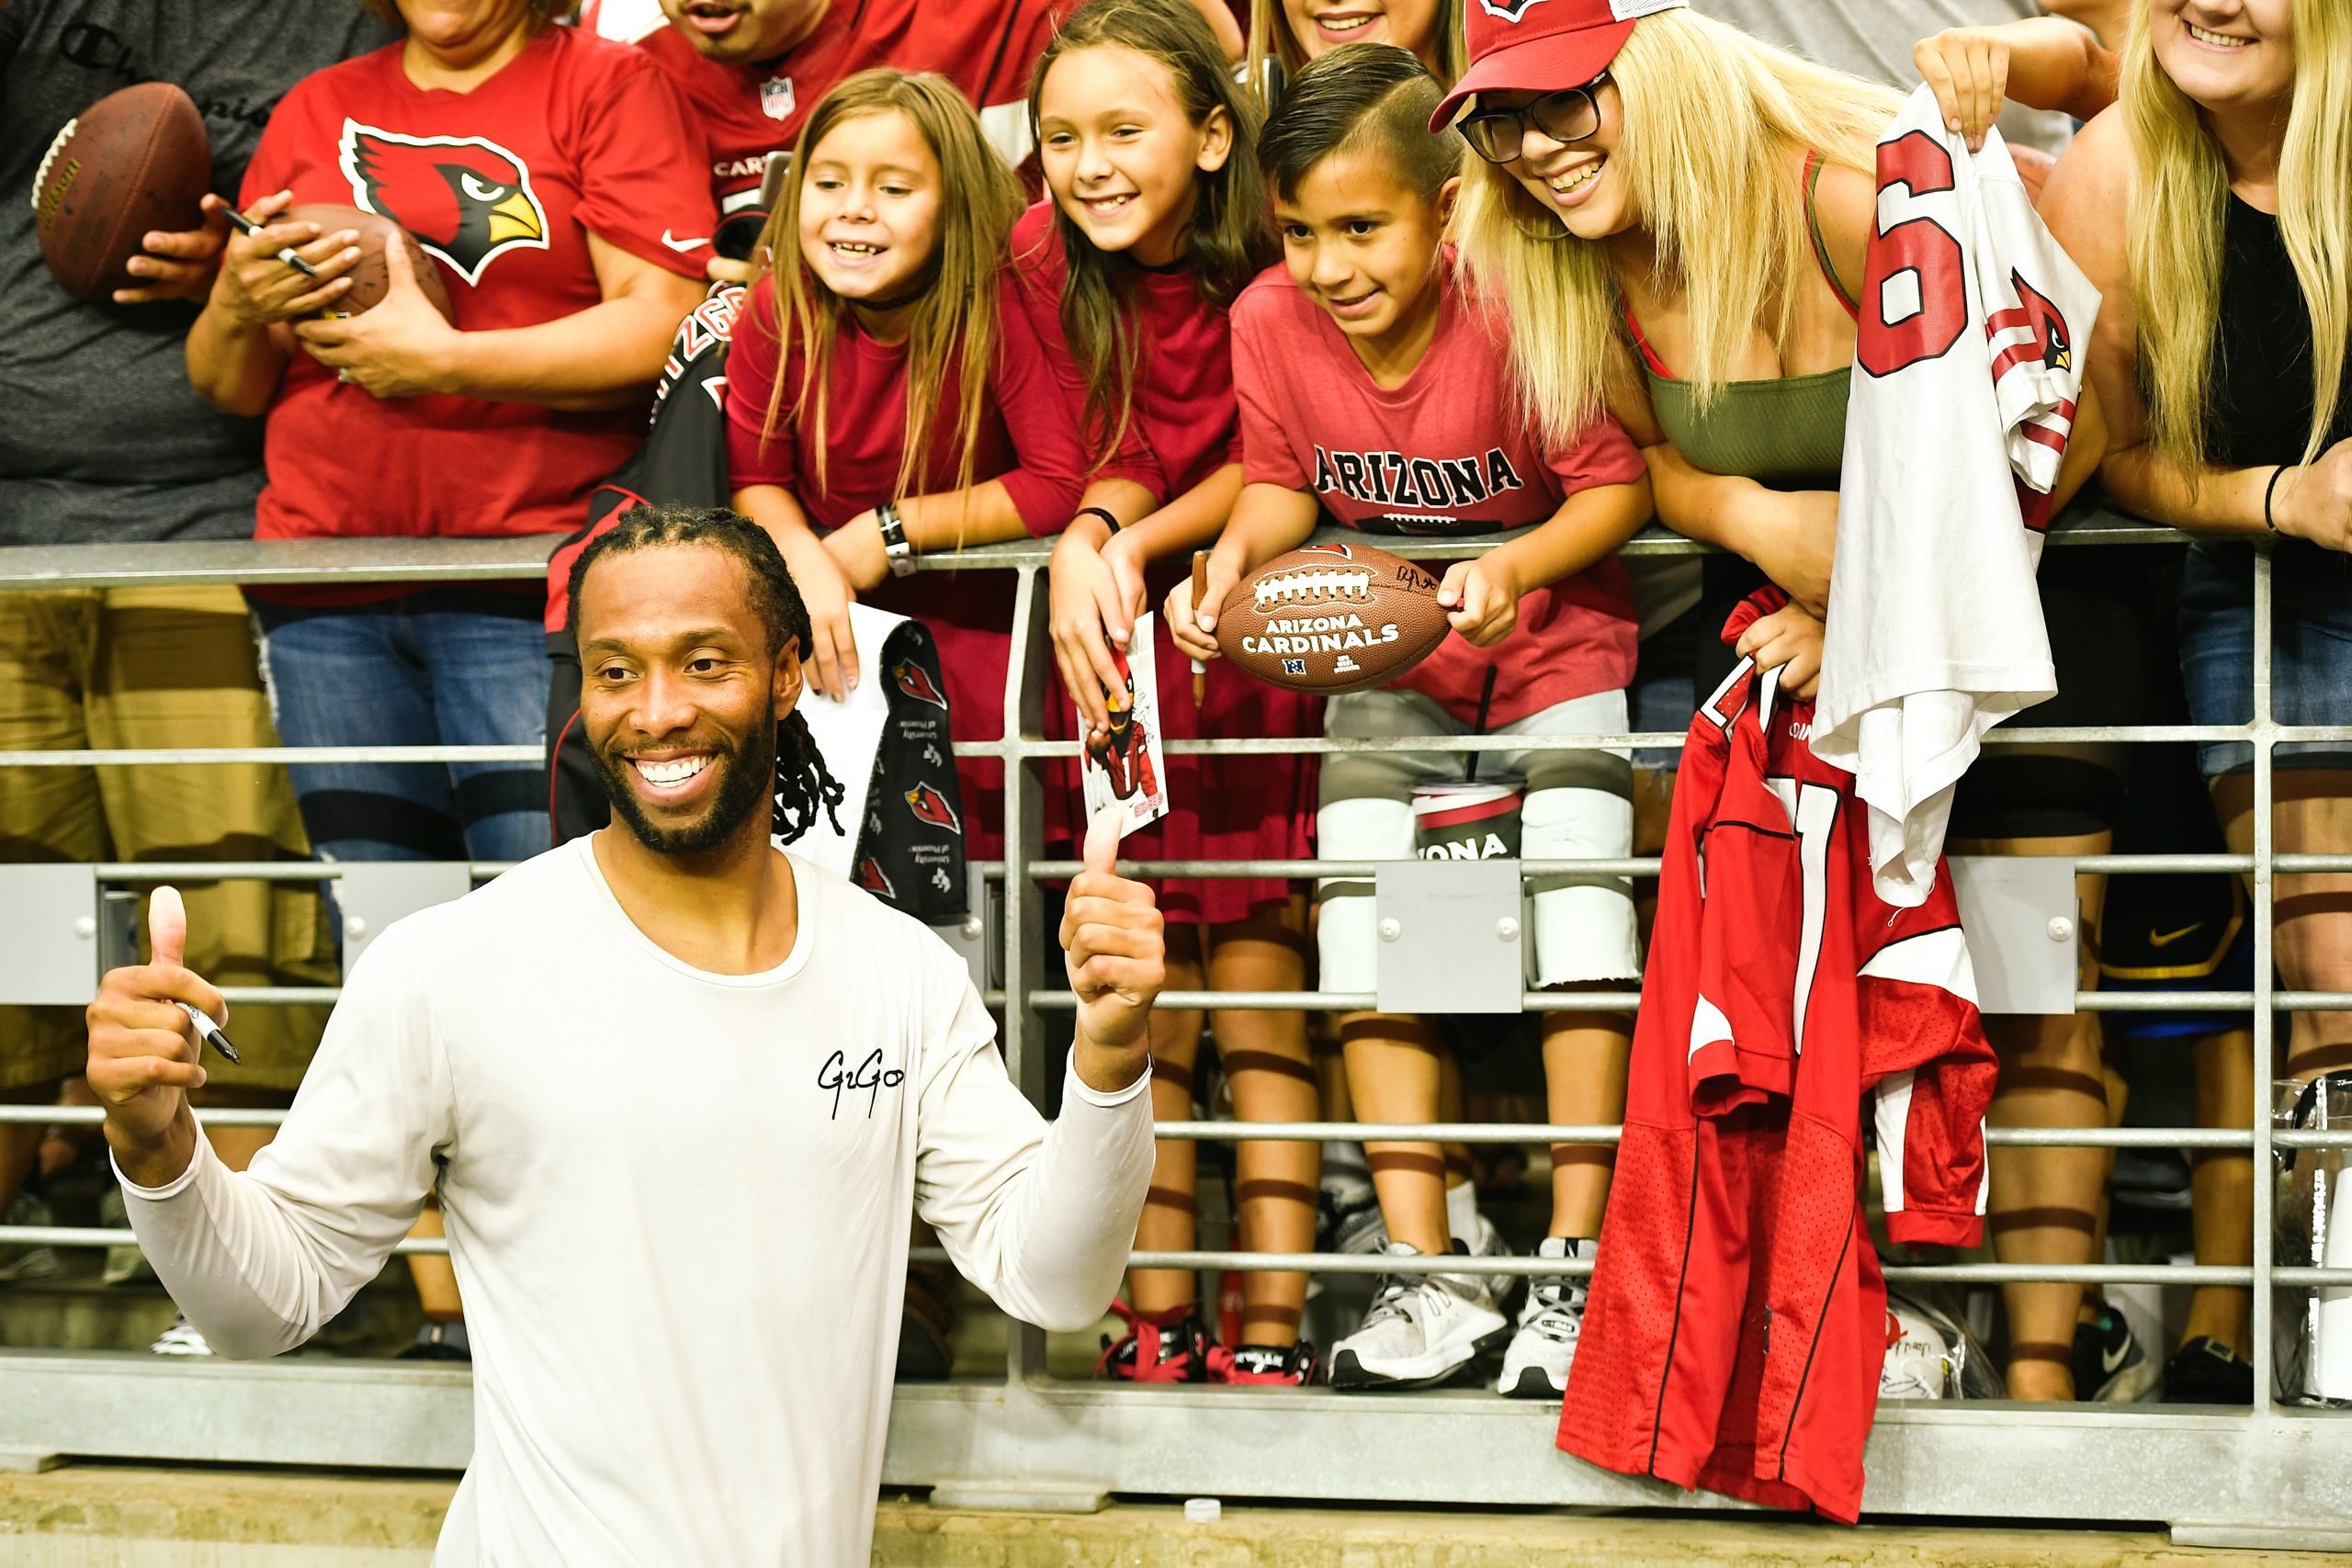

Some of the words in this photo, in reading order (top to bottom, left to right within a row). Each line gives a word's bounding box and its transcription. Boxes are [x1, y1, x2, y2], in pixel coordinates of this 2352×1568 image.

[713, 155, 768, 176] CAR
[1856, 129, 1969, 378] 6
[1314, 444, 1524, 508] ARIZONA
[1242, 623, 1399, 654] CARDINALS
[1265, 614, 1363, 635] ARIZONA
